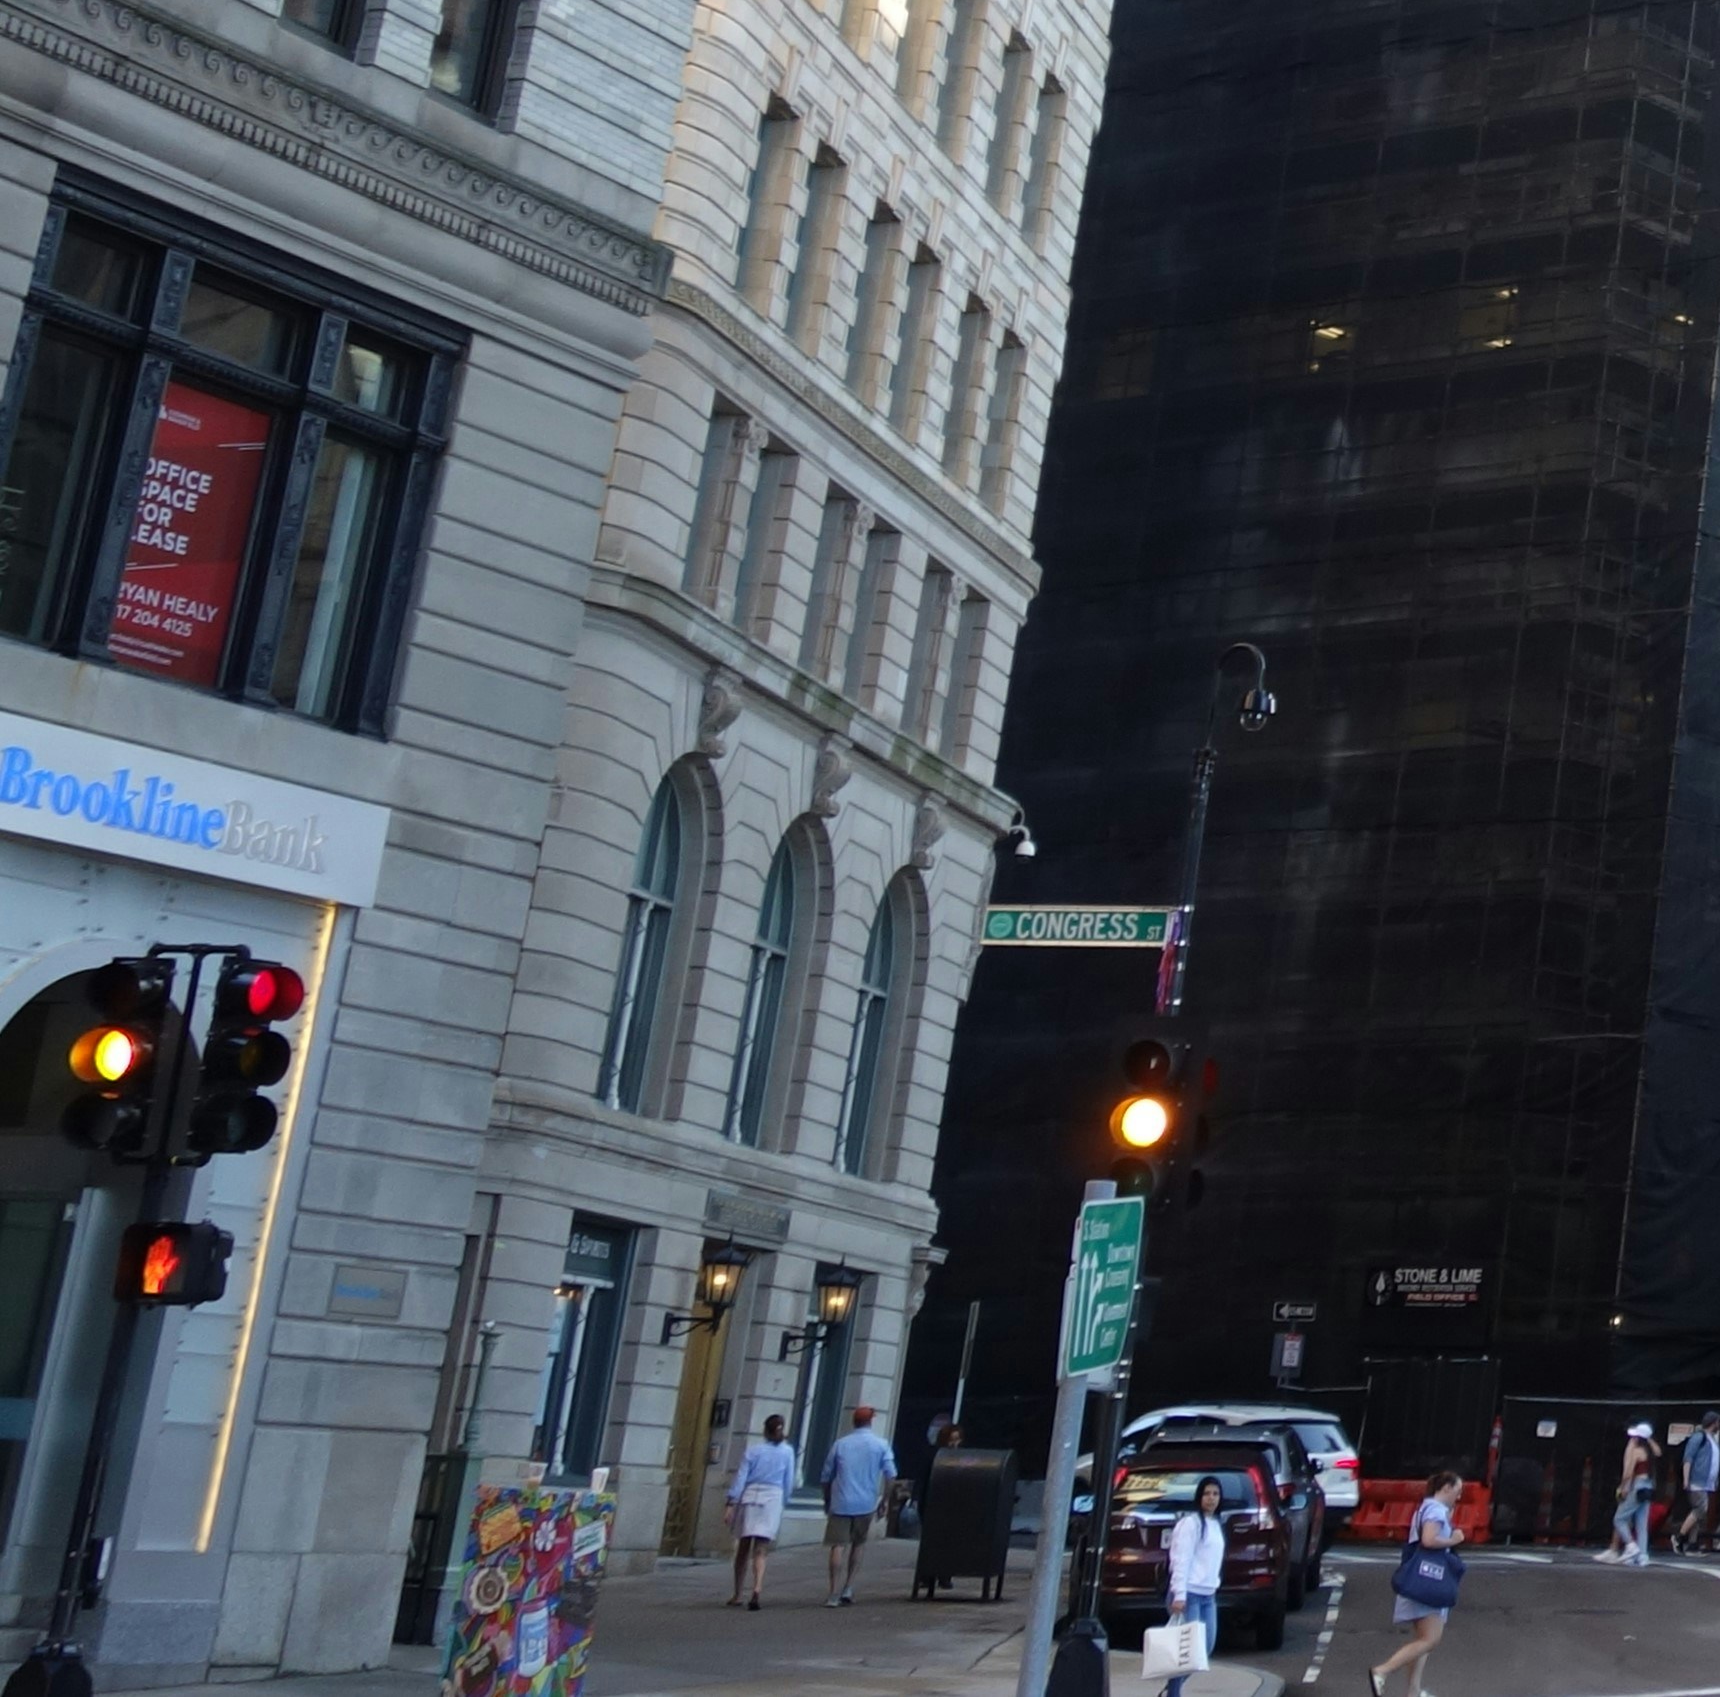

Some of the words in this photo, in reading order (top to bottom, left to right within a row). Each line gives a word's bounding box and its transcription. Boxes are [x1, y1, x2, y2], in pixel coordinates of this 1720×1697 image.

[131, 524, 190, 556] EASE
[164, 592, 219, 623] HEALY
[132, 608, 160, 630] 204
[162, 614, 194, 638] 4125
[1016, 912, 1139, 939] CONGRESS
[1147, 926, 1162, 940] ST
[1394, 1268, 1438, 1284] STONE
[1439, 1268, 1449, 1284] &
[1451, 1268, 1483, 1284] LIME
[1178, 1626, 1192, 1667] TATTE
